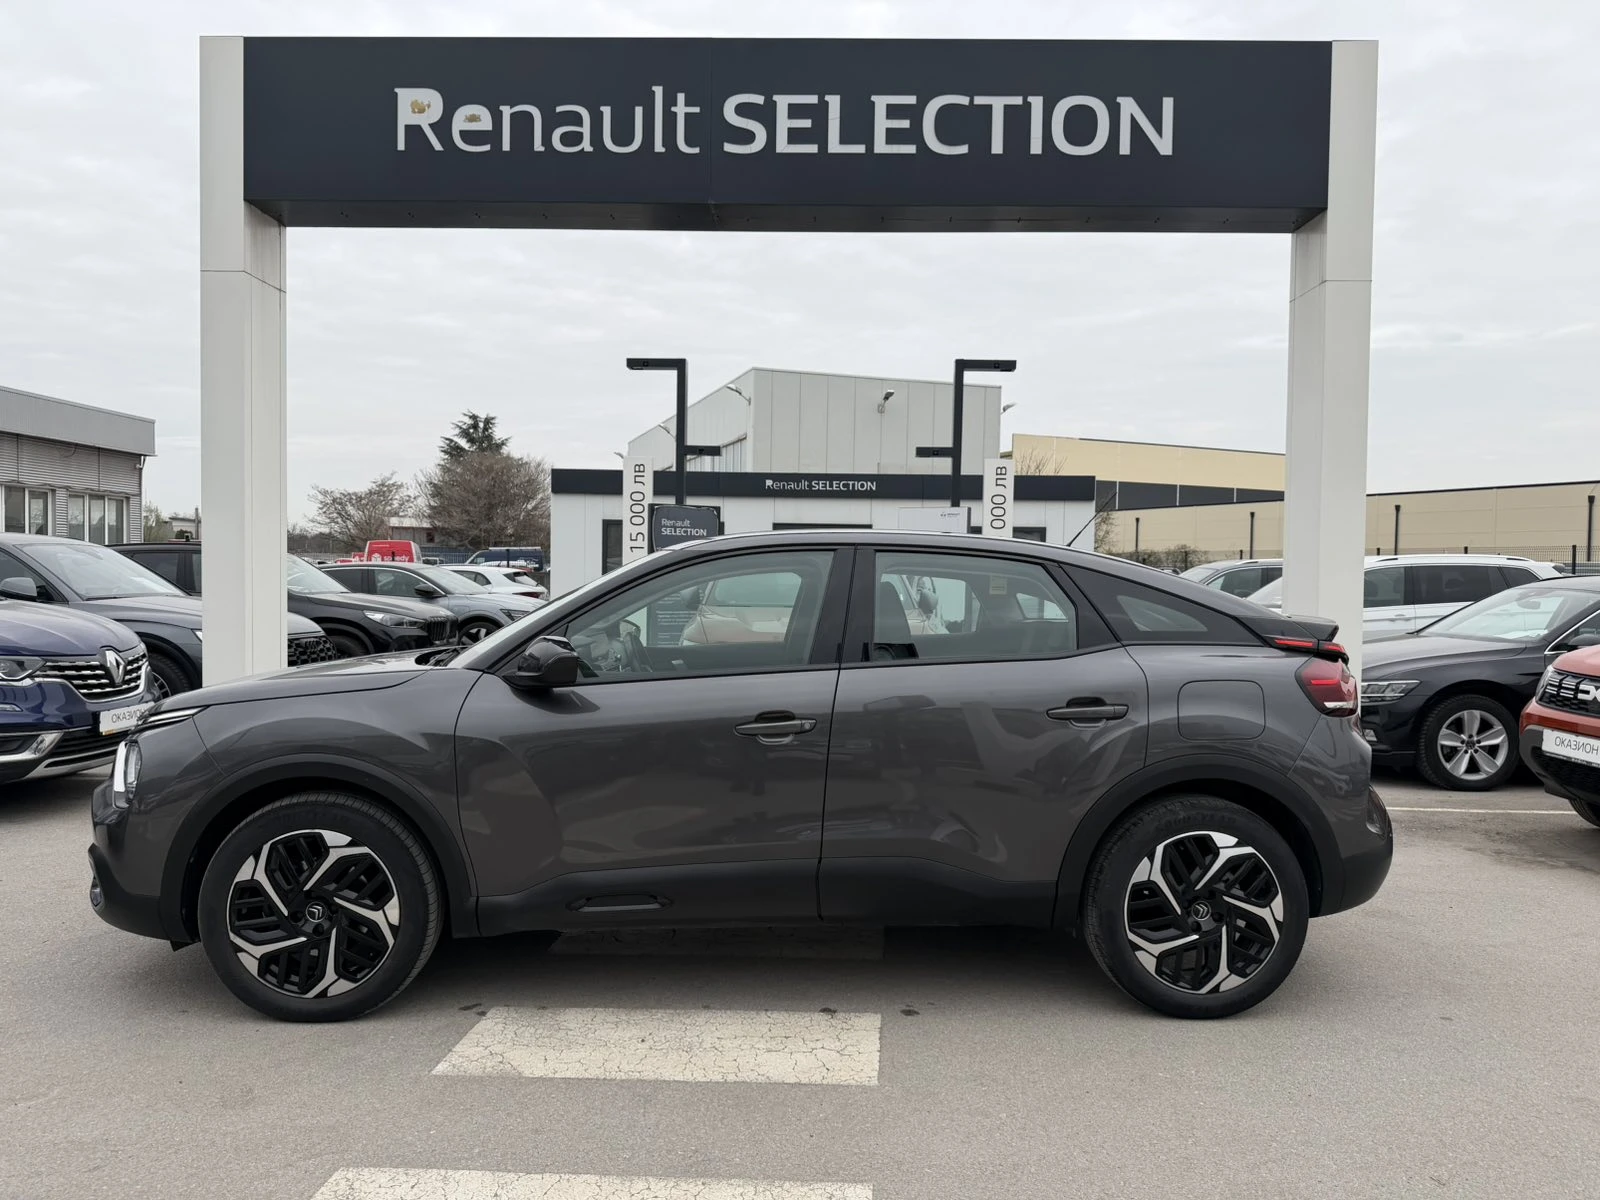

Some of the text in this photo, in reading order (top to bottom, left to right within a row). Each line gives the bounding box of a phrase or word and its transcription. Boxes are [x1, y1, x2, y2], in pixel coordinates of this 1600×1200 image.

[394, 86, 1174, 156] Renault SELECTION
[765, 479, 876, 491] Renault SELECTION
[630, 491, 645, 526] 000
[990, 494, 1006, 529] 000
[661, 518, 691, 527] Renault
[661, 528, 707, 536] SELECTION
[630, 532, 645, 553] 15
[383, 554, 410, 563] spedy
[1554, 736, 1599, 755] ОКАЗИОН
